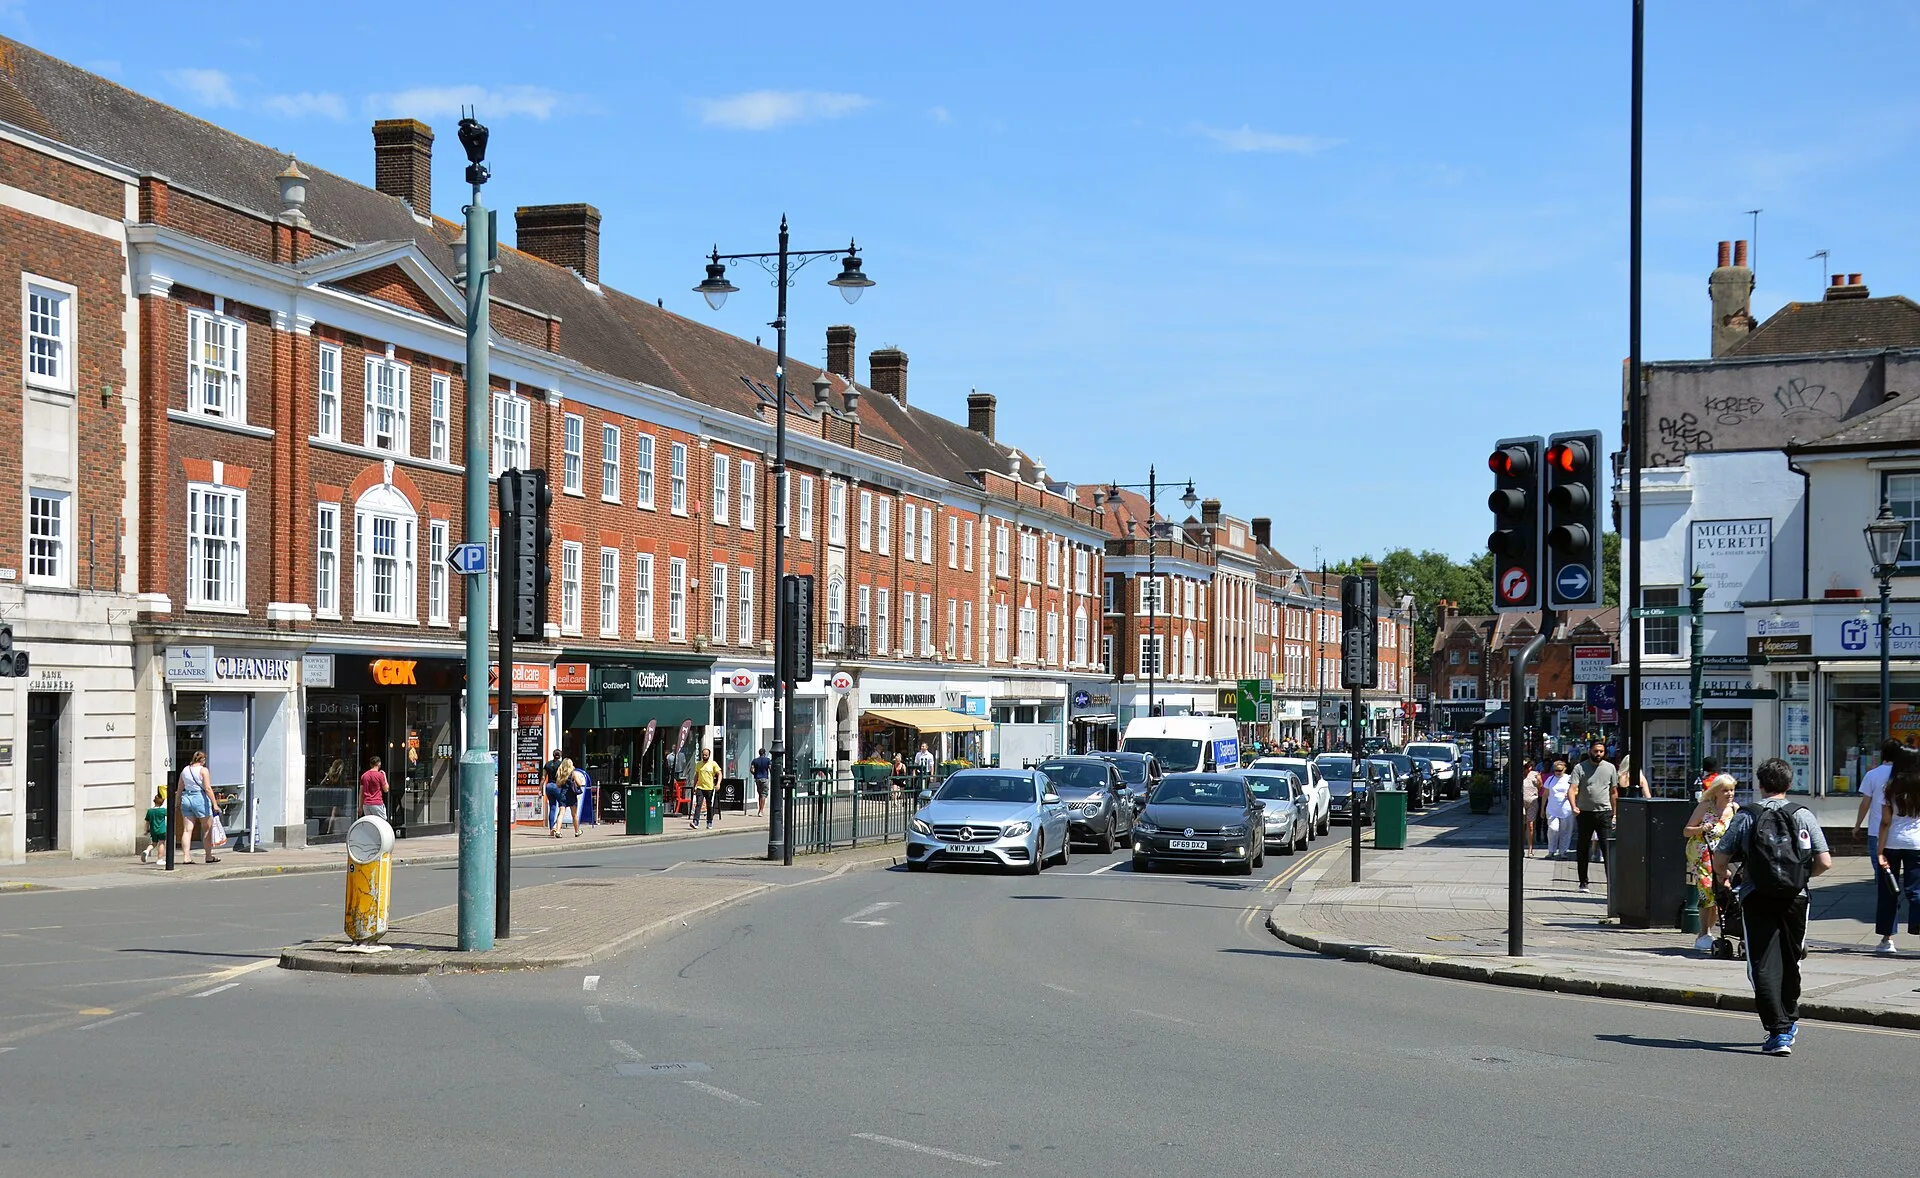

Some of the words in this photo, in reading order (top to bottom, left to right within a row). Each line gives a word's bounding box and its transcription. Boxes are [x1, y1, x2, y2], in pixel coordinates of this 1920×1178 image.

[1697, 523, 1767, 537] MICHAEL
[1697, 536, 1768, 550] EVERETT
[467, 548, 482, 569] P
[1717, 580, 1743, 588] Homes
[1872, 622, 1911, 636] Tch
[168, 668, 206, 676] CLEANERS
[215, 657, 290, 680] CLEANERS
[42, 671, 62, 679] BANK
[557, 674, 569, 683] cell
[570, 676, 586, 684] care
[29, 680, 74, 689] CHAMBERS
[1641, 681, 1684, 690] ICHAEL
[945, 692, 958, 702] W
[105, 722, 115, 732] 64
[529, 728, 542, 736] FIX
[1787, 744, 1809, 755] OPEN
[349, 863, 355, 872] 9
